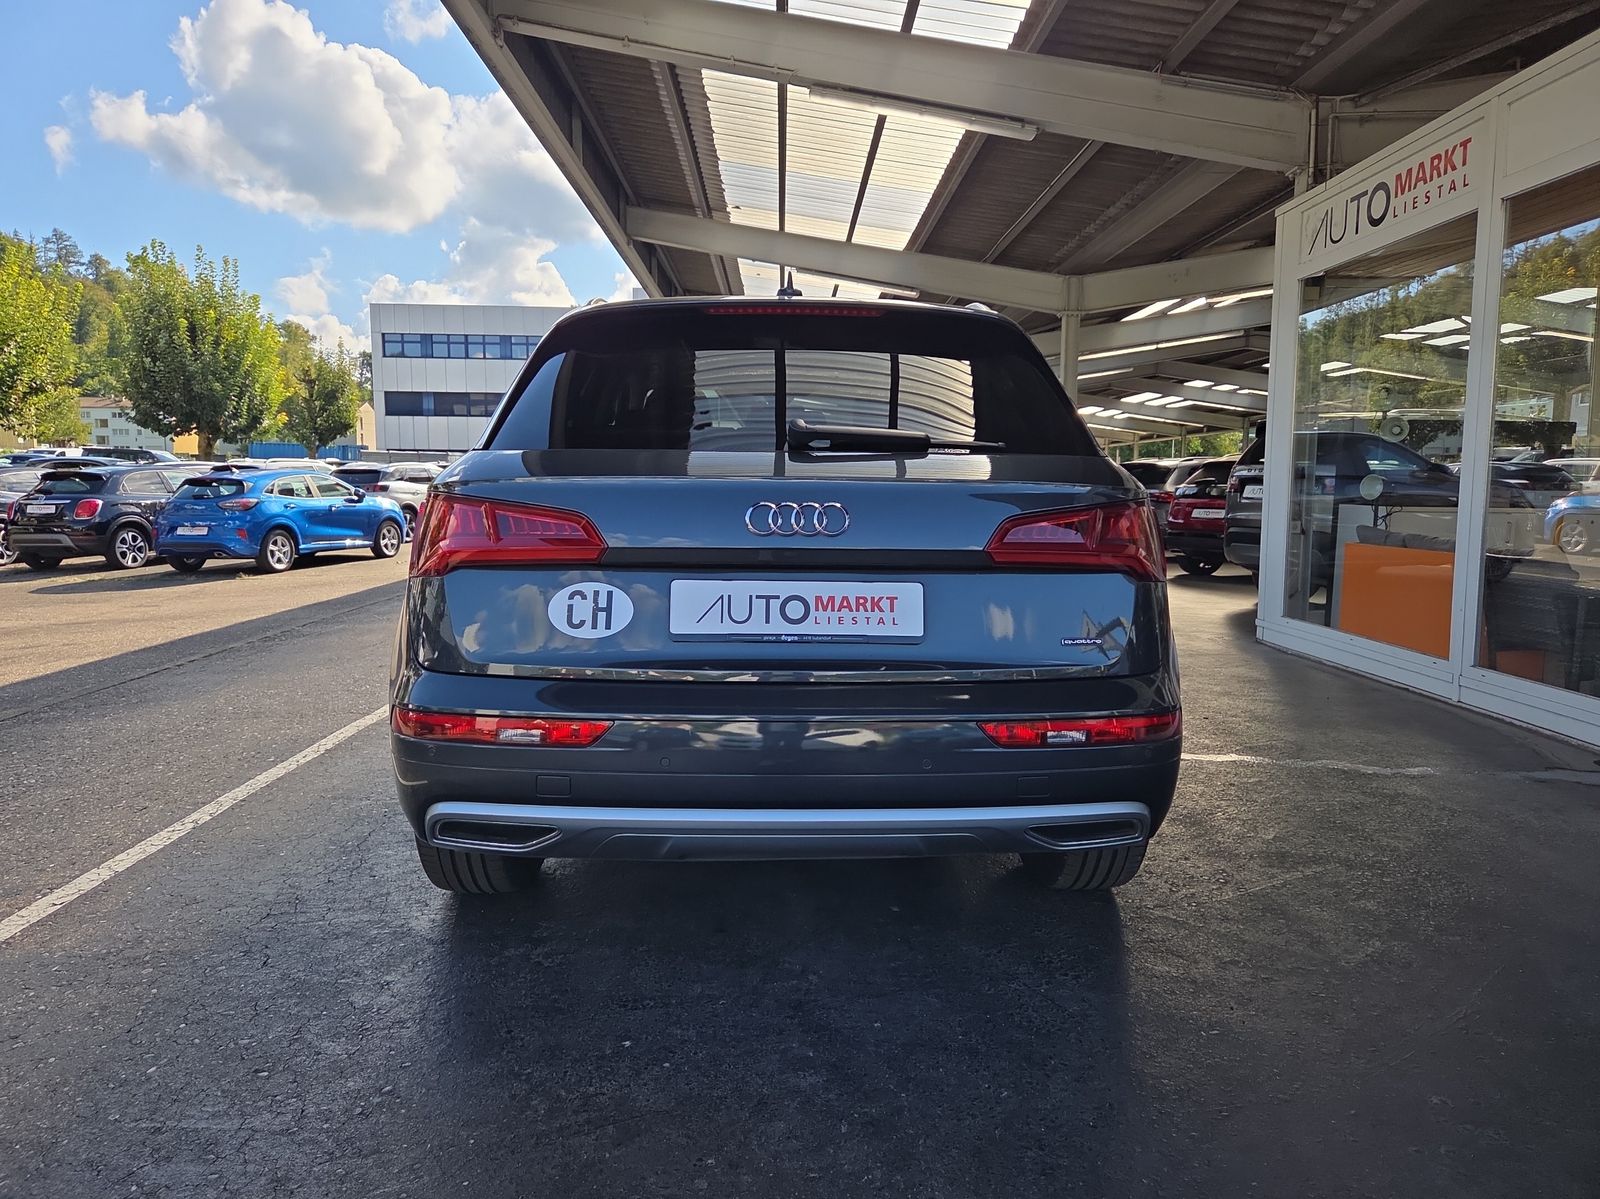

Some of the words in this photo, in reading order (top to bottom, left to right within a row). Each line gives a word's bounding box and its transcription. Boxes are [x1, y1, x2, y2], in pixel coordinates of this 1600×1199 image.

[1308, 181, 1391, 256] AUTO
[1394, 137, 1473, 199] MARKT
[1393, 174, 1470, 219] LIESTAL
[566, 589, 614, 631] CH
[695, 593, 811, 626] AUTO
[814, 595, 899, 614] MARKT
[814, 616, 899, 626] LIESTAL
